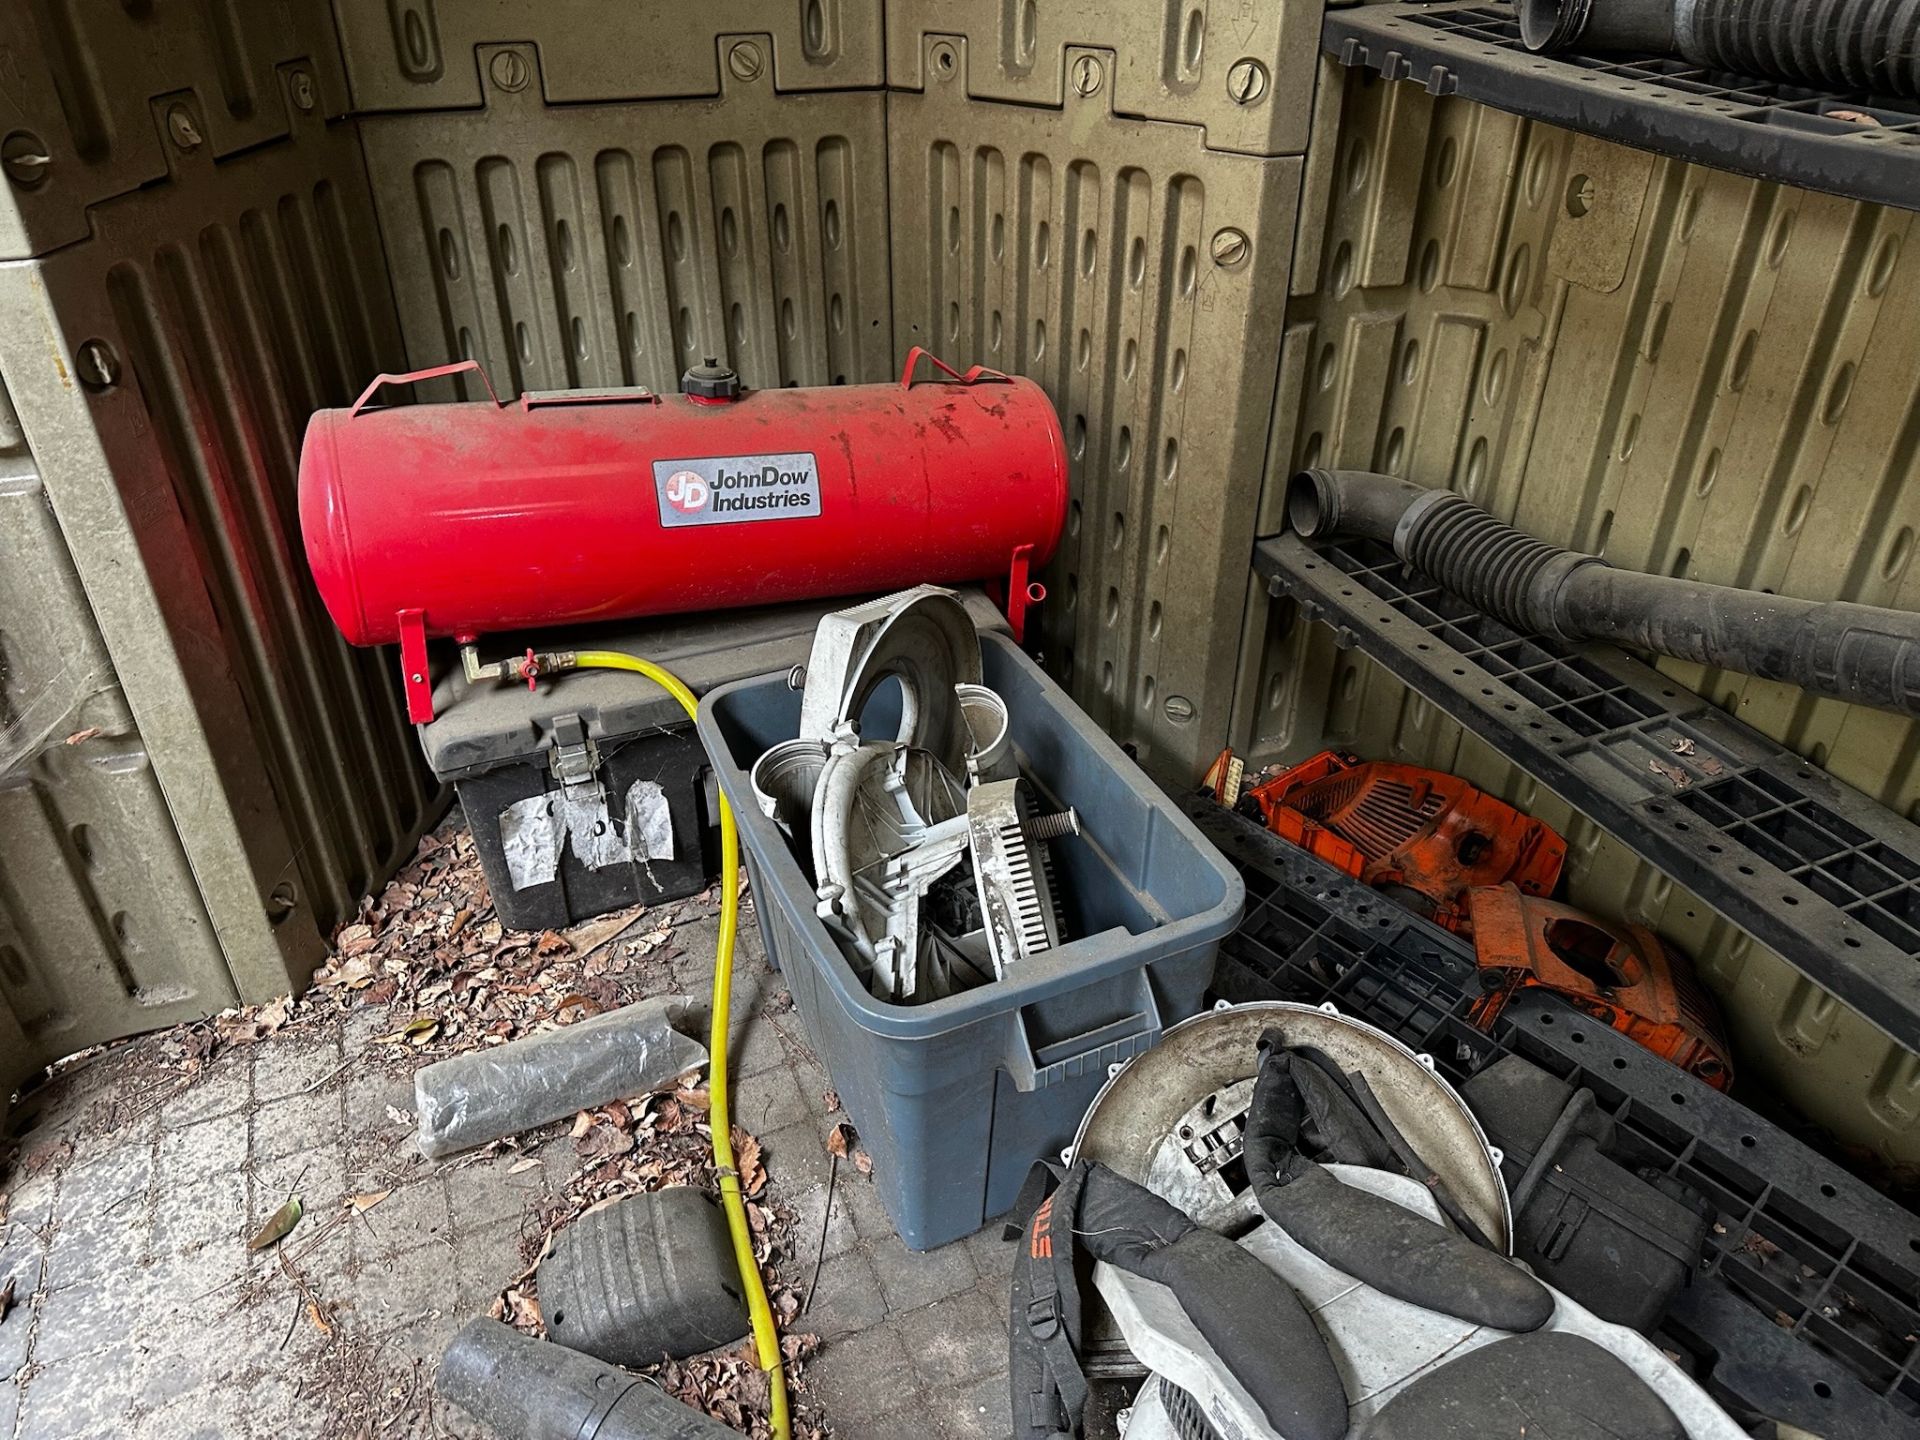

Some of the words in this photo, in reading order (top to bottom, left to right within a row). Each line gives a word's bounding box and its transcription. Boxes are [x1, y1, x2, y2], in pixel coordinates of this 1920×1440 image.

[709, 467, 809, 490] JohnDow
[668, 475, 708, 509] JD
[712, 490, 811, 512] Industries
